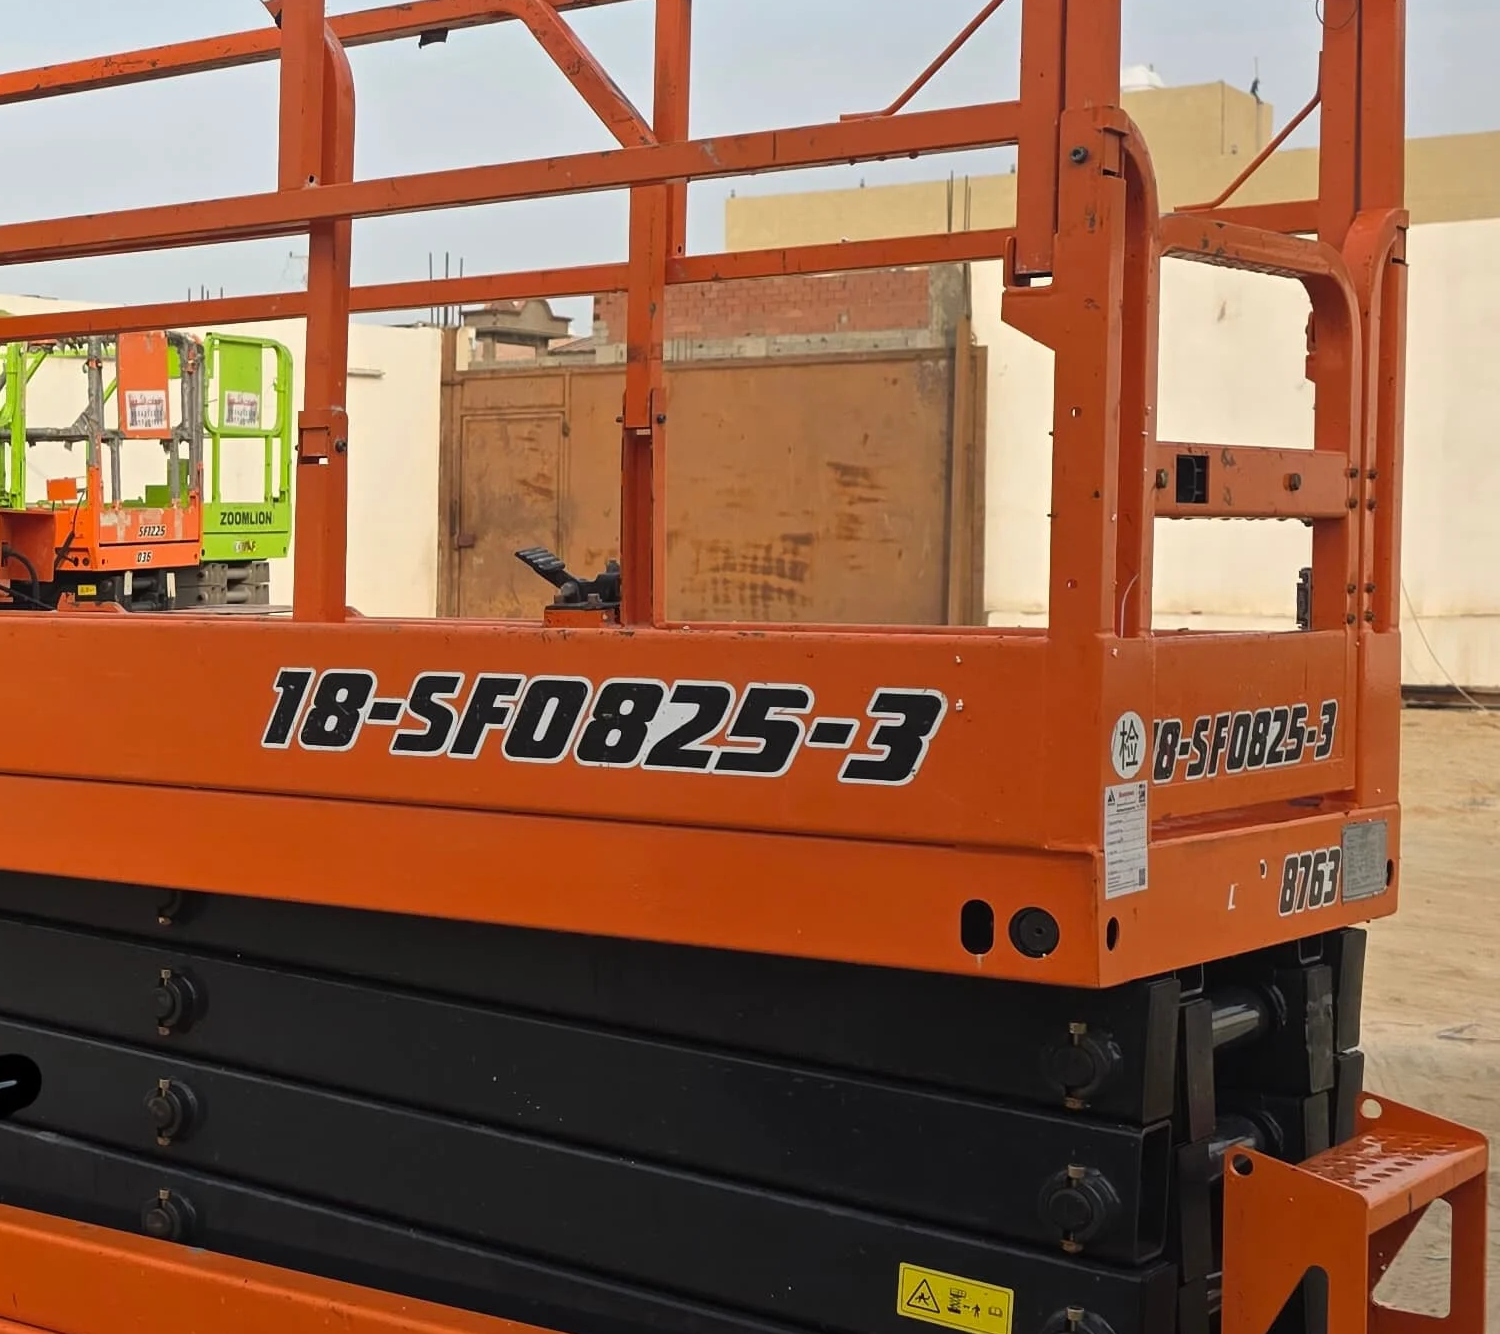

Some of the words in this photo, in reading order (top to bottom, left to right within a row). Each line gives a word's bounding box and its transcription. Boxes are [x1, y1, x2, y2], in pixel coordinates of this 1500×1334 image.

[220, 511, 272, 526] ZOOMLION
[261, 666, 948, 785] 18-SF0825-3
[1118, 718, 1140, 771] 检
[1278, 846, 1342, 916] 8763
